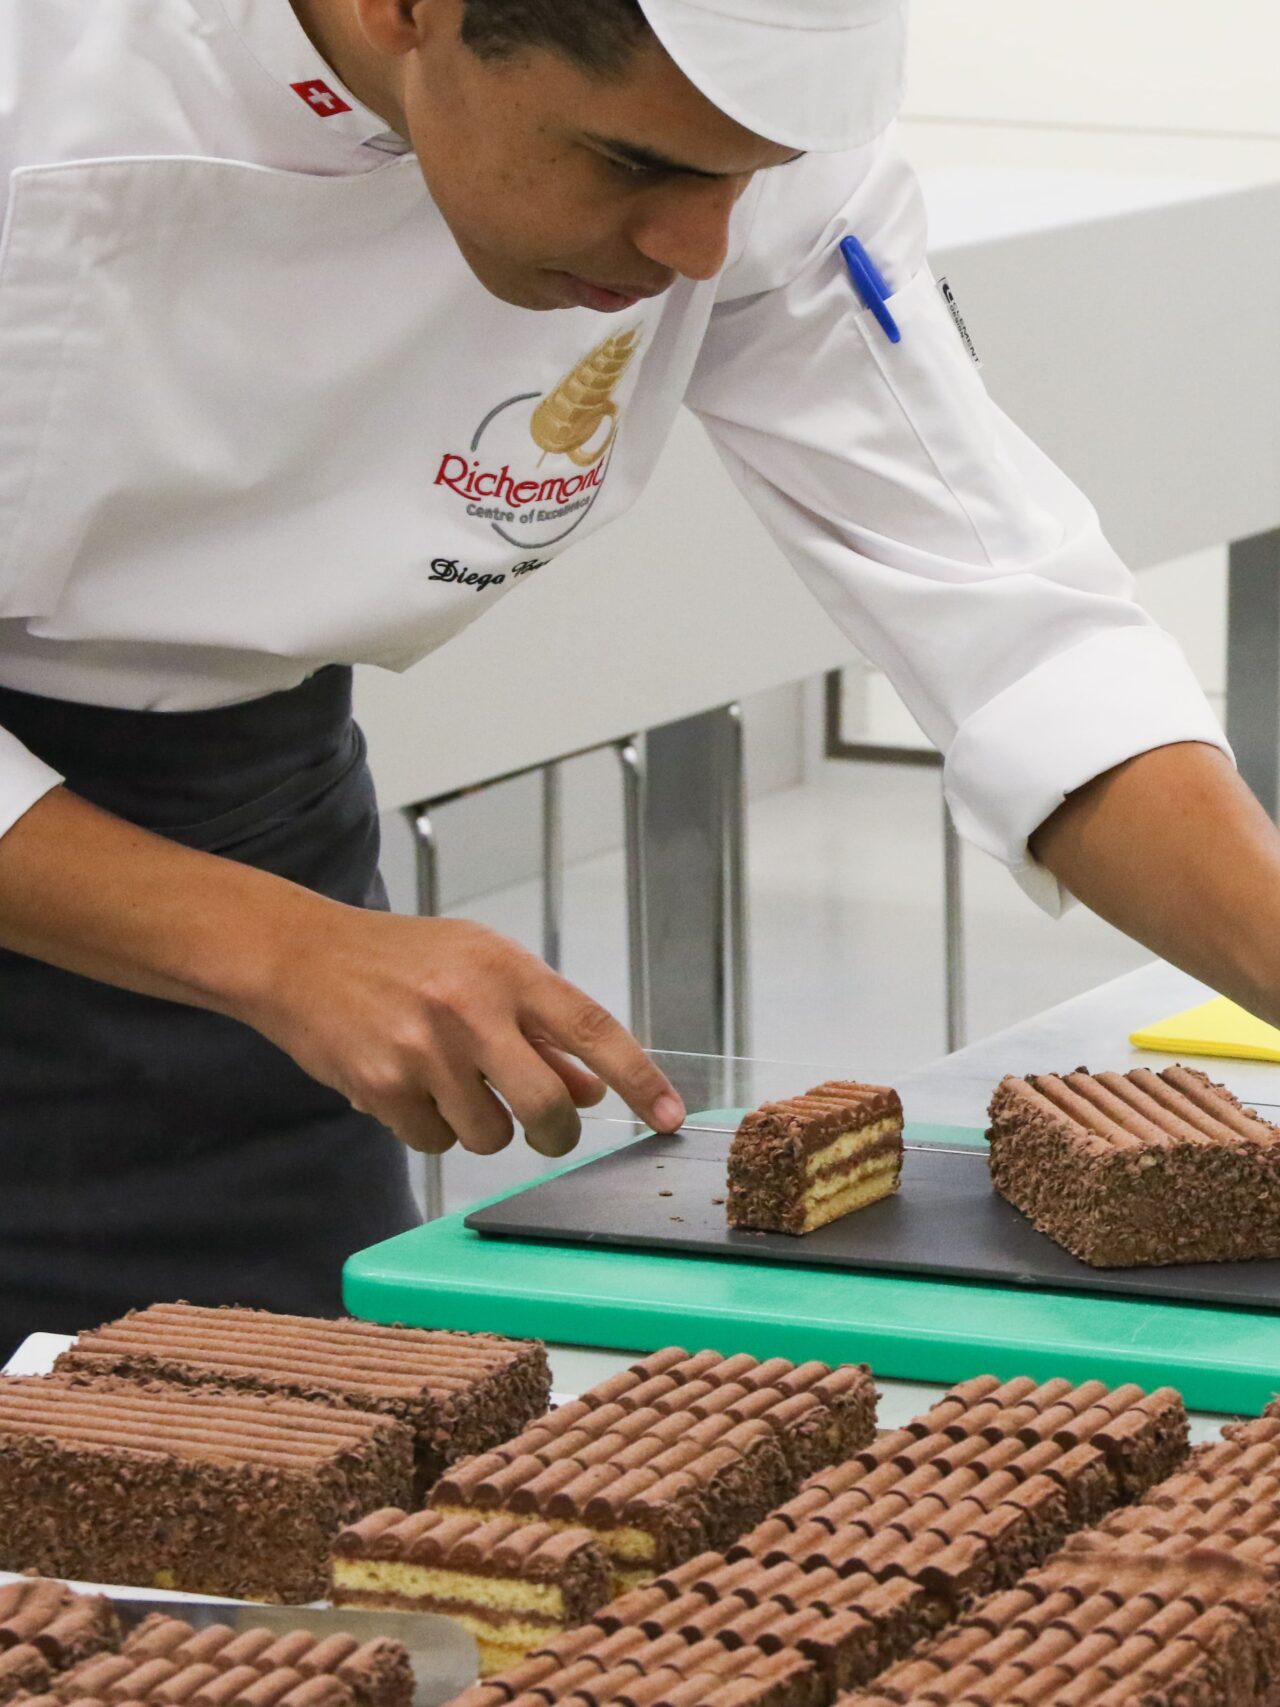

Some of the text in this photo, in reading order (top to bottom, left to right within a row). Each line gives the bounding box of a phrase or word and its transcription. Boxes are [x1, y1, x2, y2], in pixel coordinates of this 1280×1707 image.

[433, 453, 605, 508] Richemont
[466, 502, 514, 523] Centre
[519, 508, 535, 524] of
[428, 558, 505, 592] Diego
